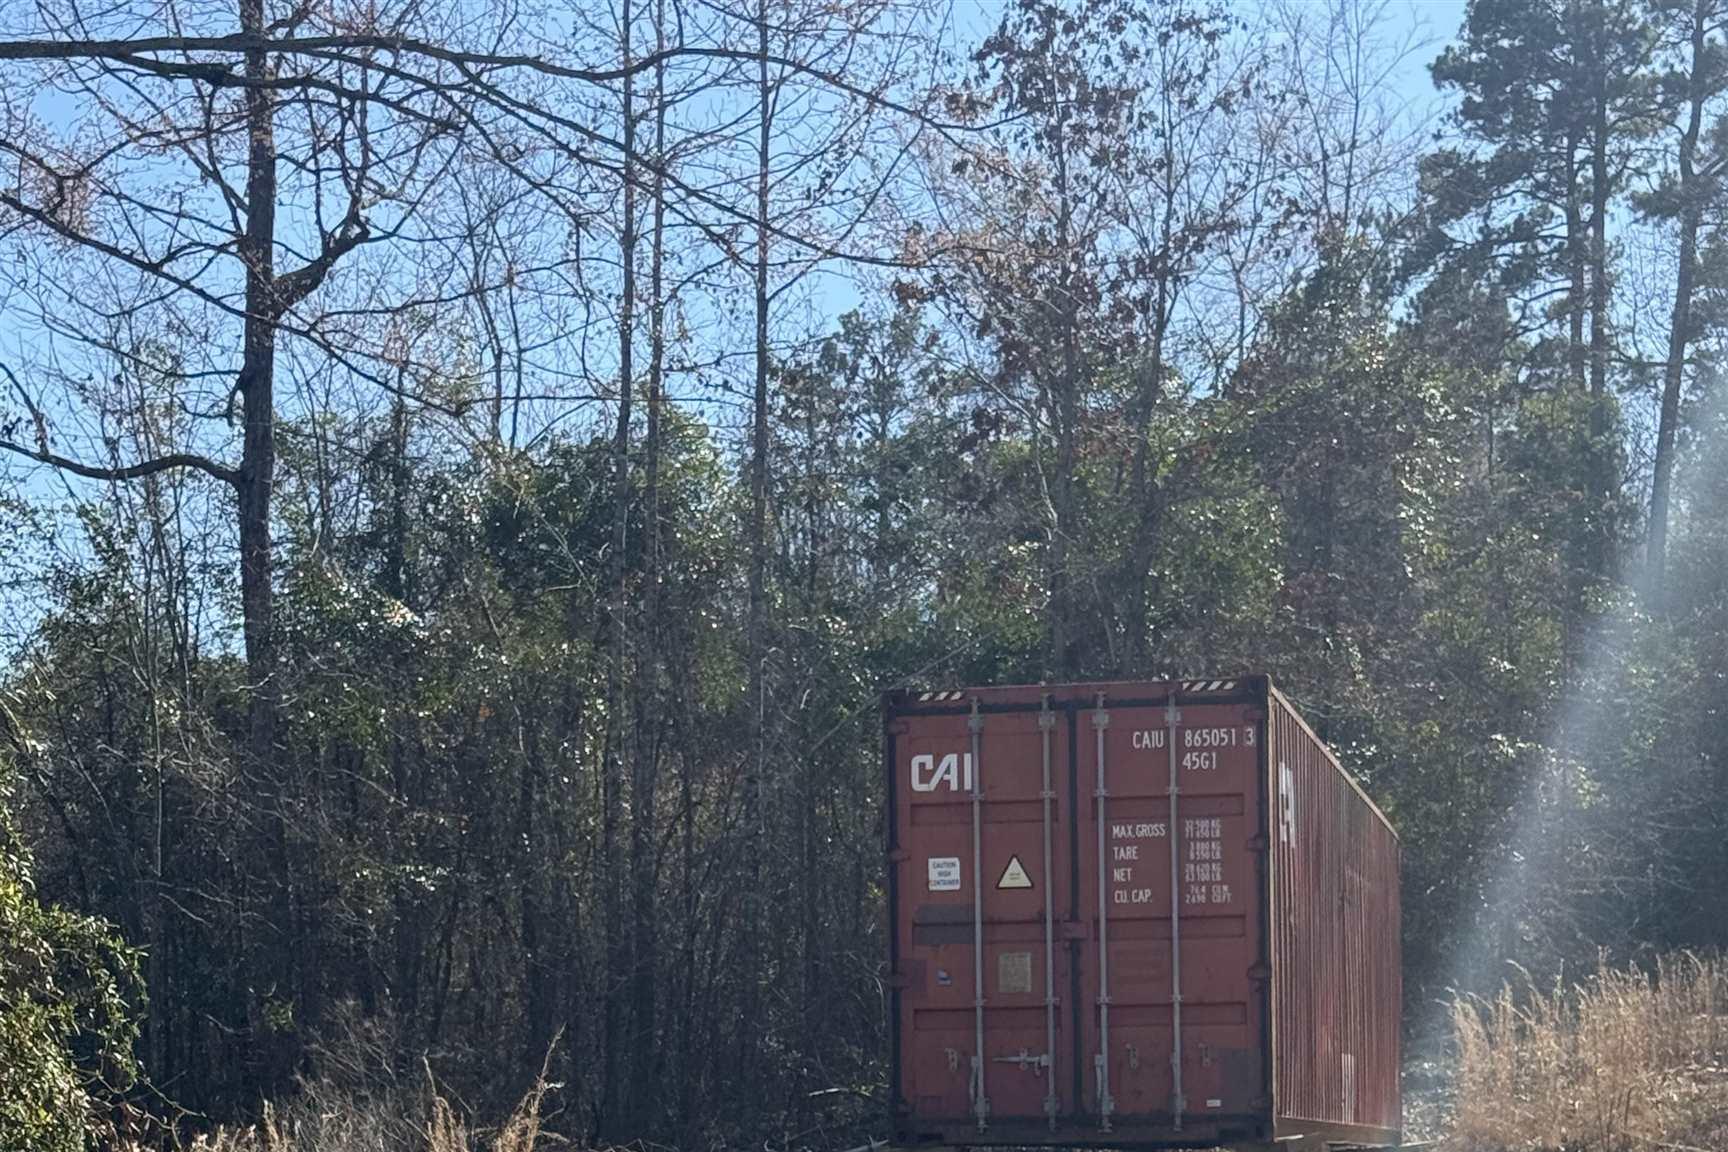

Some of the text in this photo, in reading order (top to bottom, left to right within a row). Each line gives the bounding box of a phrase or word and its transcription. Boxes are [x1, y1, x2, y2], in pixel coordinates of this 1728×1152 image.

[1132, 727, 1255, 749] CAIU 865051 3
[1182, 752, 1217, 770] 45G1
[911, 753, 972, 792] CAI
[1113, 846, 1139, 860] TARE
[1113, 868, 1132, 881] NET
